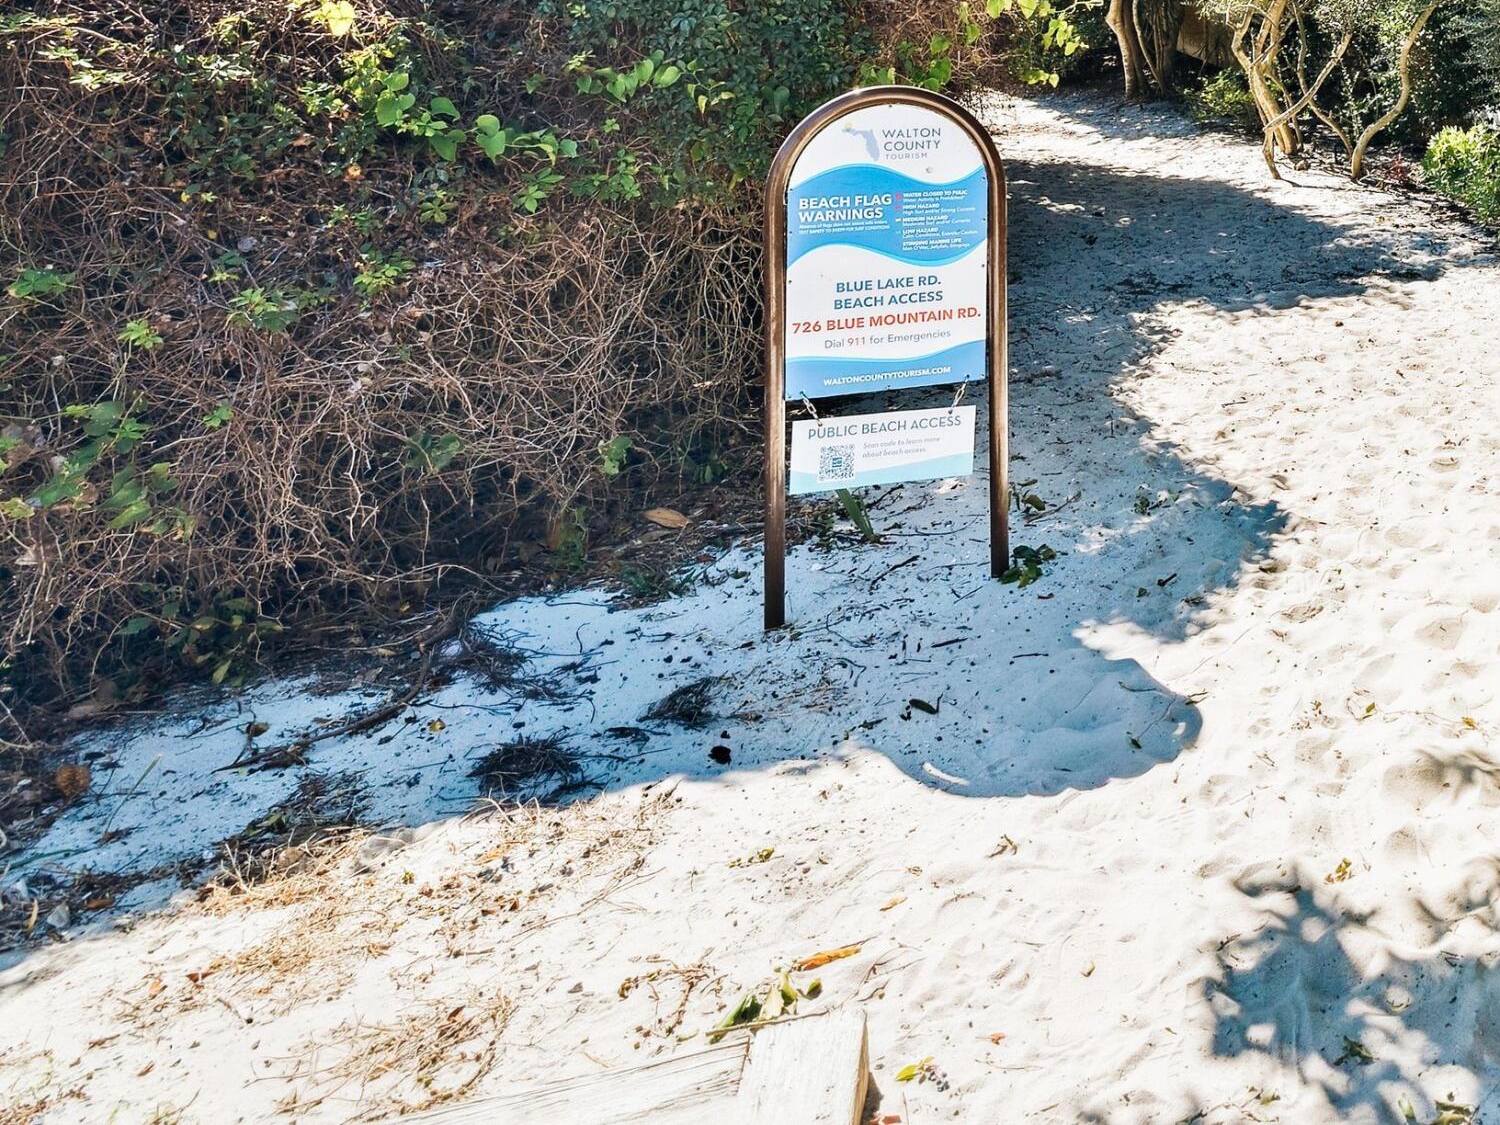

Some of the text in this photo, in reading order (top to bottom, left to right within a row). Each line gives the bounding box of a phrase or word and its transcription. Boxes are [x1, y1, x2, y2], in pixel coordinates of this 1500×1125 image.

[882, 127, 941, 139] WALTON
[883, 139, 941, 152] COUNTY
[885, 152, 928, 160] TOURISM
[799, 193, 892, 210] BEACH FLAG
[798, 207, 884, 223] WARNINGS
[835, 274, 942, 293] BLUE LAKE RD.
[834, 291, 943, 310] BEACH ACCESS
[792, 306, 981, 335] 726 BLUE MOUNTAIN RD.
[824, 328, 951, 350] Dial 911 for Emergencies
[823, 365, 952, 387] WALTONCOUNTYTOURISM.COM
[808, 415, 962, 441] PUBLIC BEACH ACCESS
[863, 441, 879, 450] Scan
[880, 440, 896, 448] code
[897, 439, 905, 447] to
[905, 438, 923, 446] learn
[862, 449, 882, 459] about
[882, 448, 903, 457] beach
